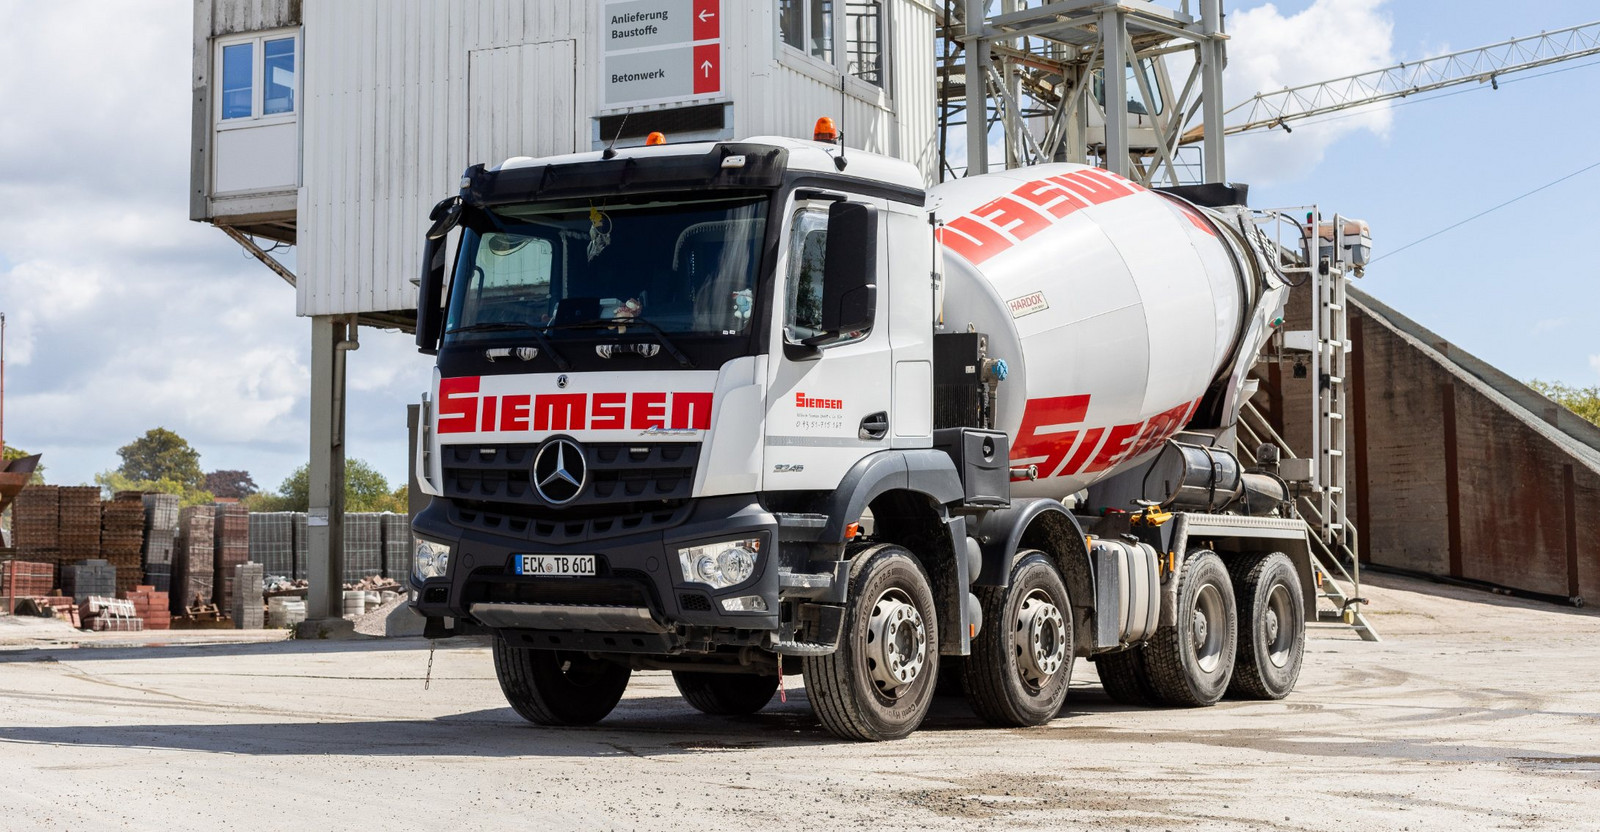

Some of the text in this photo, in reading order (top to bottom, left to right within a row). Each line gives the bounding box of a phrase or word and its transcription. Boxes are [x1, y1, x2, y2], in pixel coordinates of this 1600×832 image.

[611, 10, 668, 24] Anlieferung
[611, 25, 658, 39] Baustoffe
[611, 69, 665, 83] Betonwerk
[1010, 294, 1043, 311] HARDOX
[523, 557, 594, 573] ECK TB 601
[920, 585, 936, 645] Continental
[1060, 654, 1071, 686] Hybrid
